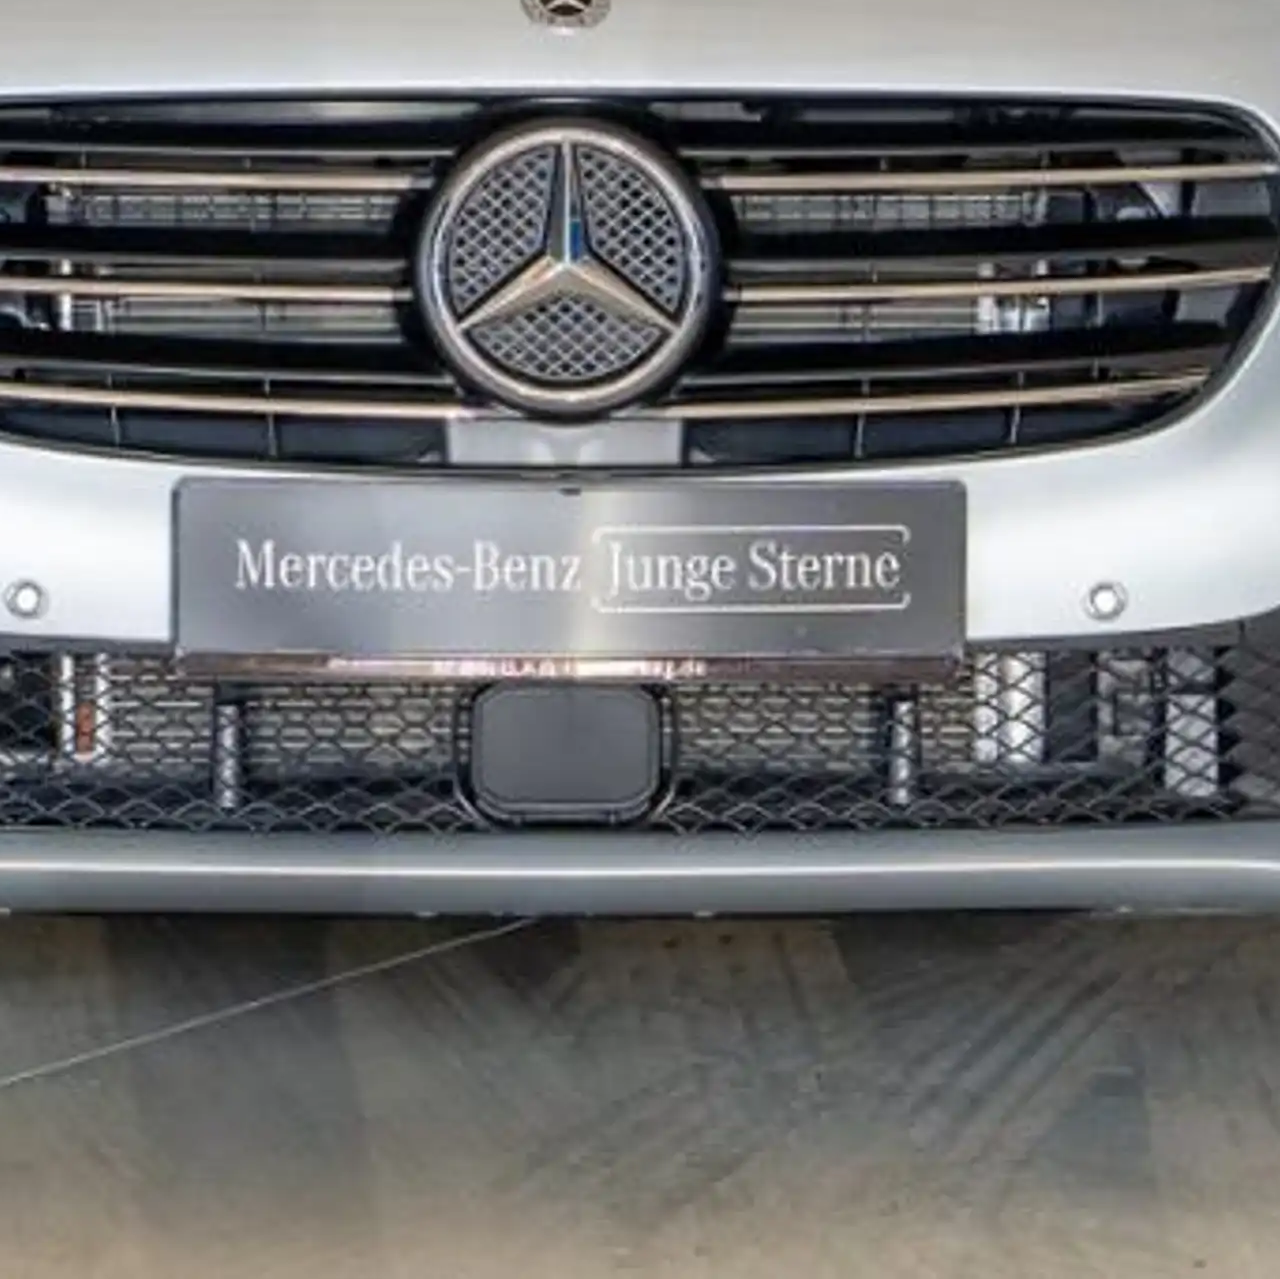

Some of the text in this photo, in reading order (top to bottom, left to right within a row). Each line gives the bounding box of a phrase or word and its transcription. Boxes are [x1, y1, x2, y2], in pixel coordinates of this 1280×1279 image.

[234, 539, 901, 602] Mercedes-Benz Junge Sterne
